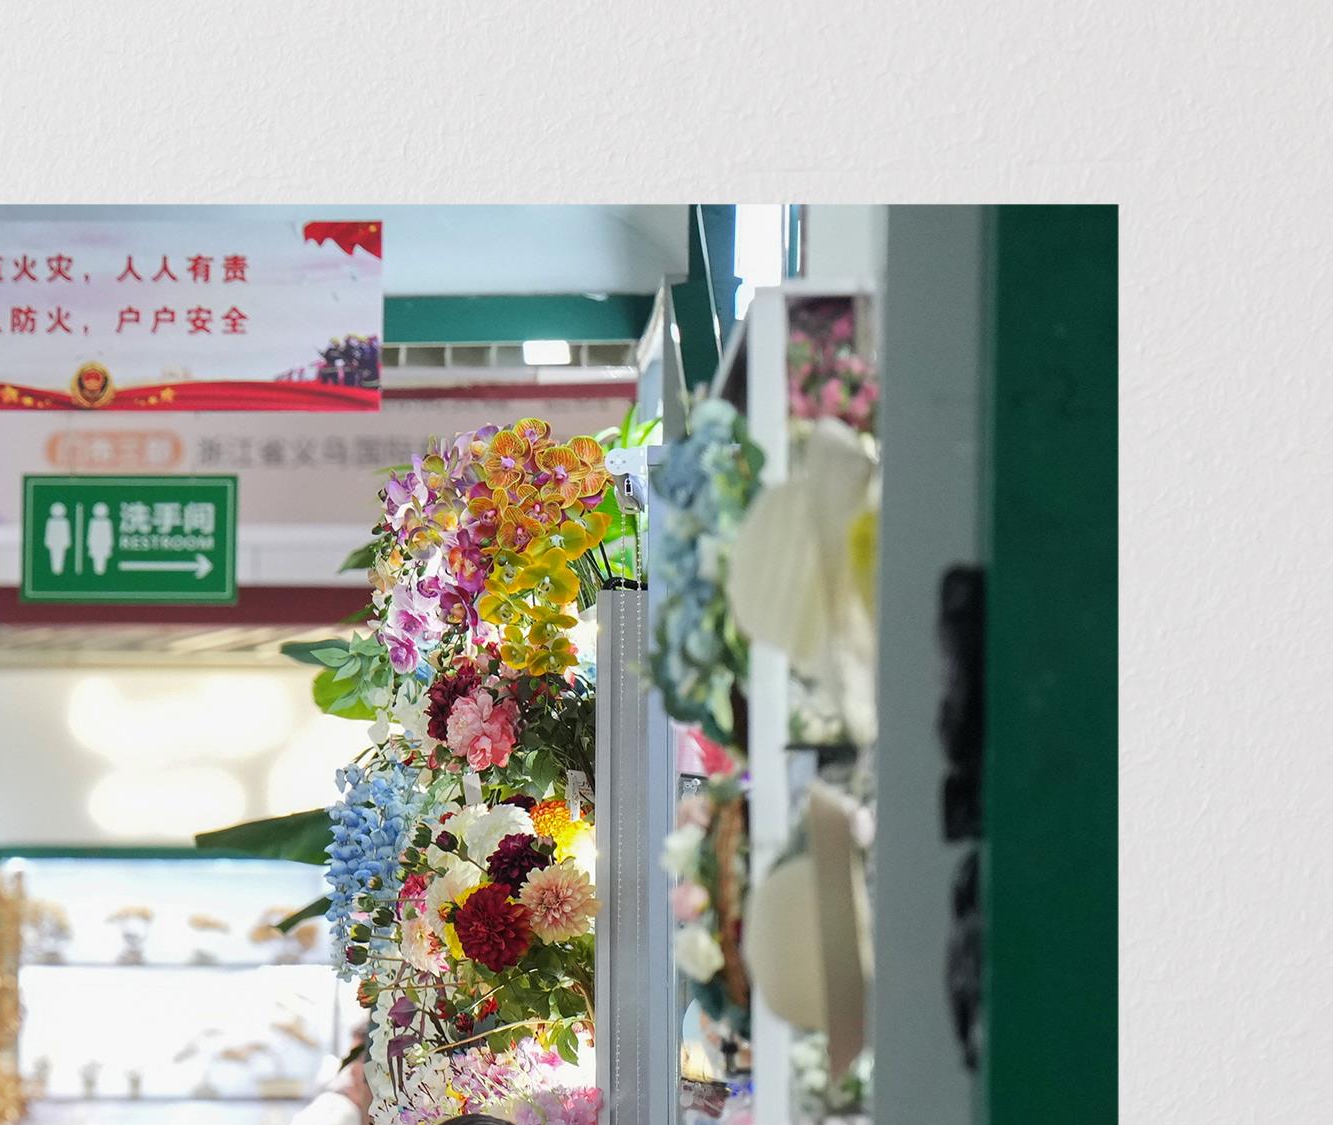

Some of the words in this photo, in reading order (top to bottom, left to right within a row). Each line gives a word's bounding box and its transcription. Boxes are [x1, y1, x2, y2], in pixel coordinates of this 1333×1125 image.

[119, 501, 215, 534] 洗手间
[119, 534, 215, 552] RESTROOM
